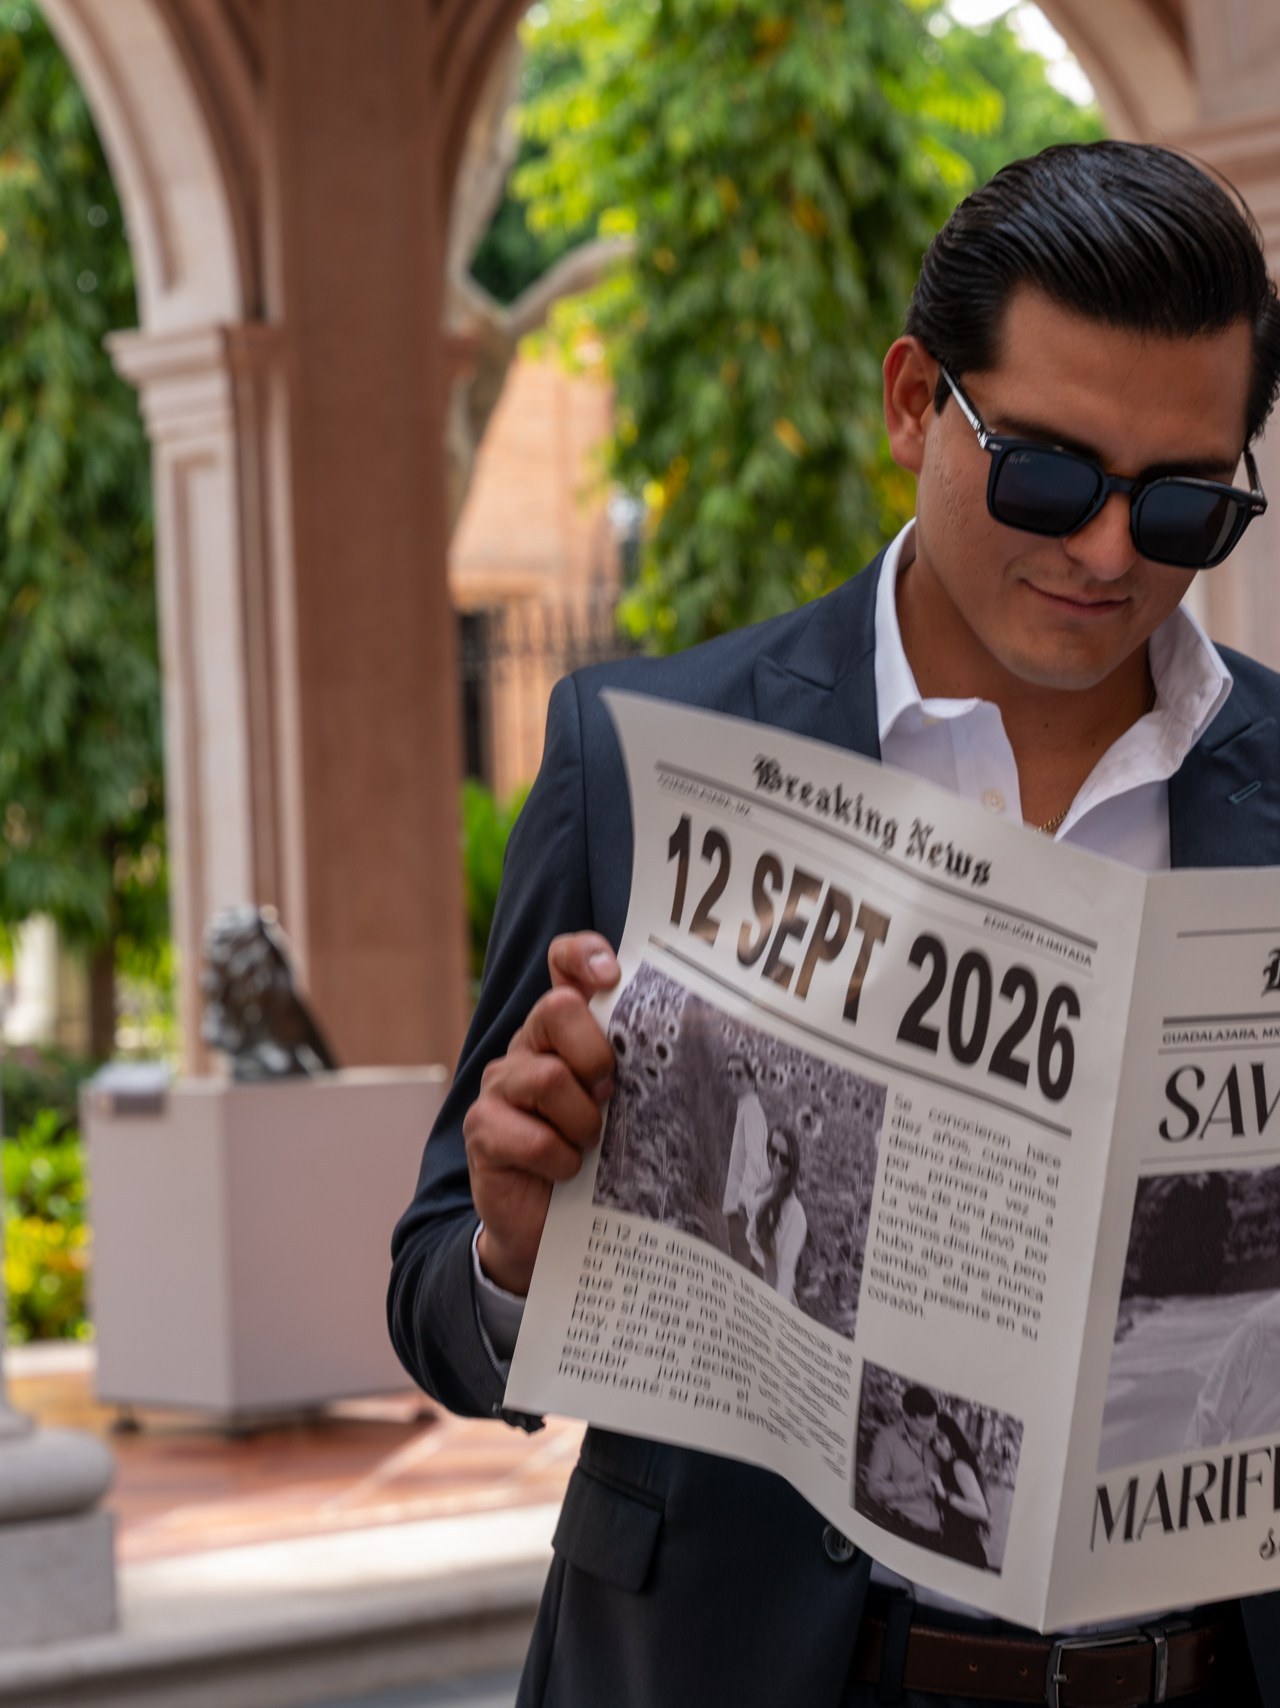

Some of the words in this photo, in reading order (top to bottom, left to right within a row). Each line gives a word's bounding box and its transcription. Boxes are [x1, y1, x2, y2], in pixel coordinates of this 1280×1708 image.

[752, 752, 900, 855] Breaking
[905, 818, 995, 888] News
[667, 811, 732, 947] 12
[736, 851, 892, 1027] SEPT
[896, 930, 1081, 1103] 2026
[1033, 929, 1093, 969] ILIMITADA
[891, 1114, 922, 1136] diez
[932, 1131, 971, 1156] años,
[981, 1147, 1037, 1180] cuando
[1046, 1173, 1059, 1189] el
[894, 1094, 913, 1112] Se
[928, 1108, 1011, 1150] conocieron
[1026, 1142, 1062, 1170] hace
[886, 1154, 910, 1173] por
[927, 1168, 988, 1202] primera
[1005, 1196, 1029, 1217] vez
[1044, 1213, 1054, 1228] a
[888, 1133, 944, 1165] destino
[1008, 1178, 1057, 1209] unirlos
[592, 1217, 608, 1234] El
[638, 1231, 658, 1248] de
[881, 1190, 898, 1209] La
[908, 1201, 939, 1224] vida
[949, 1212, 970, 1235] los
[1024, 1245, 1049, 1265] por
[931, 1189, 952, 1207] de
[956, 1199, 985, 1221] una
[588, 1235, 704, 1282] transformaron
[711, 1276, 727, 1294] en
[875, 1227, 914, 1254] hubo
[920, 1246, 954, 1268] algo
[960, 1261, 990, 1281] que
[997, 1274, 1044, 1304] nunca
[878, 1212, 940, 1244] caminos
[1012, 1260, 1047, 1285] pero
[571, 1290, 615, 1320] pero
[640, 1302, 680, 1328] llega
[686, 1317, 704, 1335] en
[710, 1326, 722, 1341] el
[579, 1273, 613, 1294] que
[623, 1281, 638, 1298] el
[648, 1289, 689, 1313] amor
[700, 1305, 718, 1324] no
[725, 1316, 772, 1355] siempre
[583, 1254, 602, 1273] su
[615, 1260, 677, 1291] historia
[687, 1283, 726, 1311] como
[870, 1267, 917, 1296] estuvo
[923, 1287, 990, 1322] presente
[996, 1312, 1015, 1332] en
[1021, 1323, 1038, 1342] su
[942, 1274, 969, 1295] ella
[980, 1288, 1042, 1322] siempre
[567, 1326, 599, 1345] una
[691, 1354, 751, 1386] deciden
[571, 1305, 608, 1332] Hoy,
[615, 1317, 648, 1337] con
[655, 1328, 686, 1349] una
[562, 1345, 627, 1370] escribir
[656, 1364, 711, 1391] juntos
[736, 1387, 749, 1404] el
[669, 1385, 688, 1402] su
[694, 1392, 731, 1414] para
